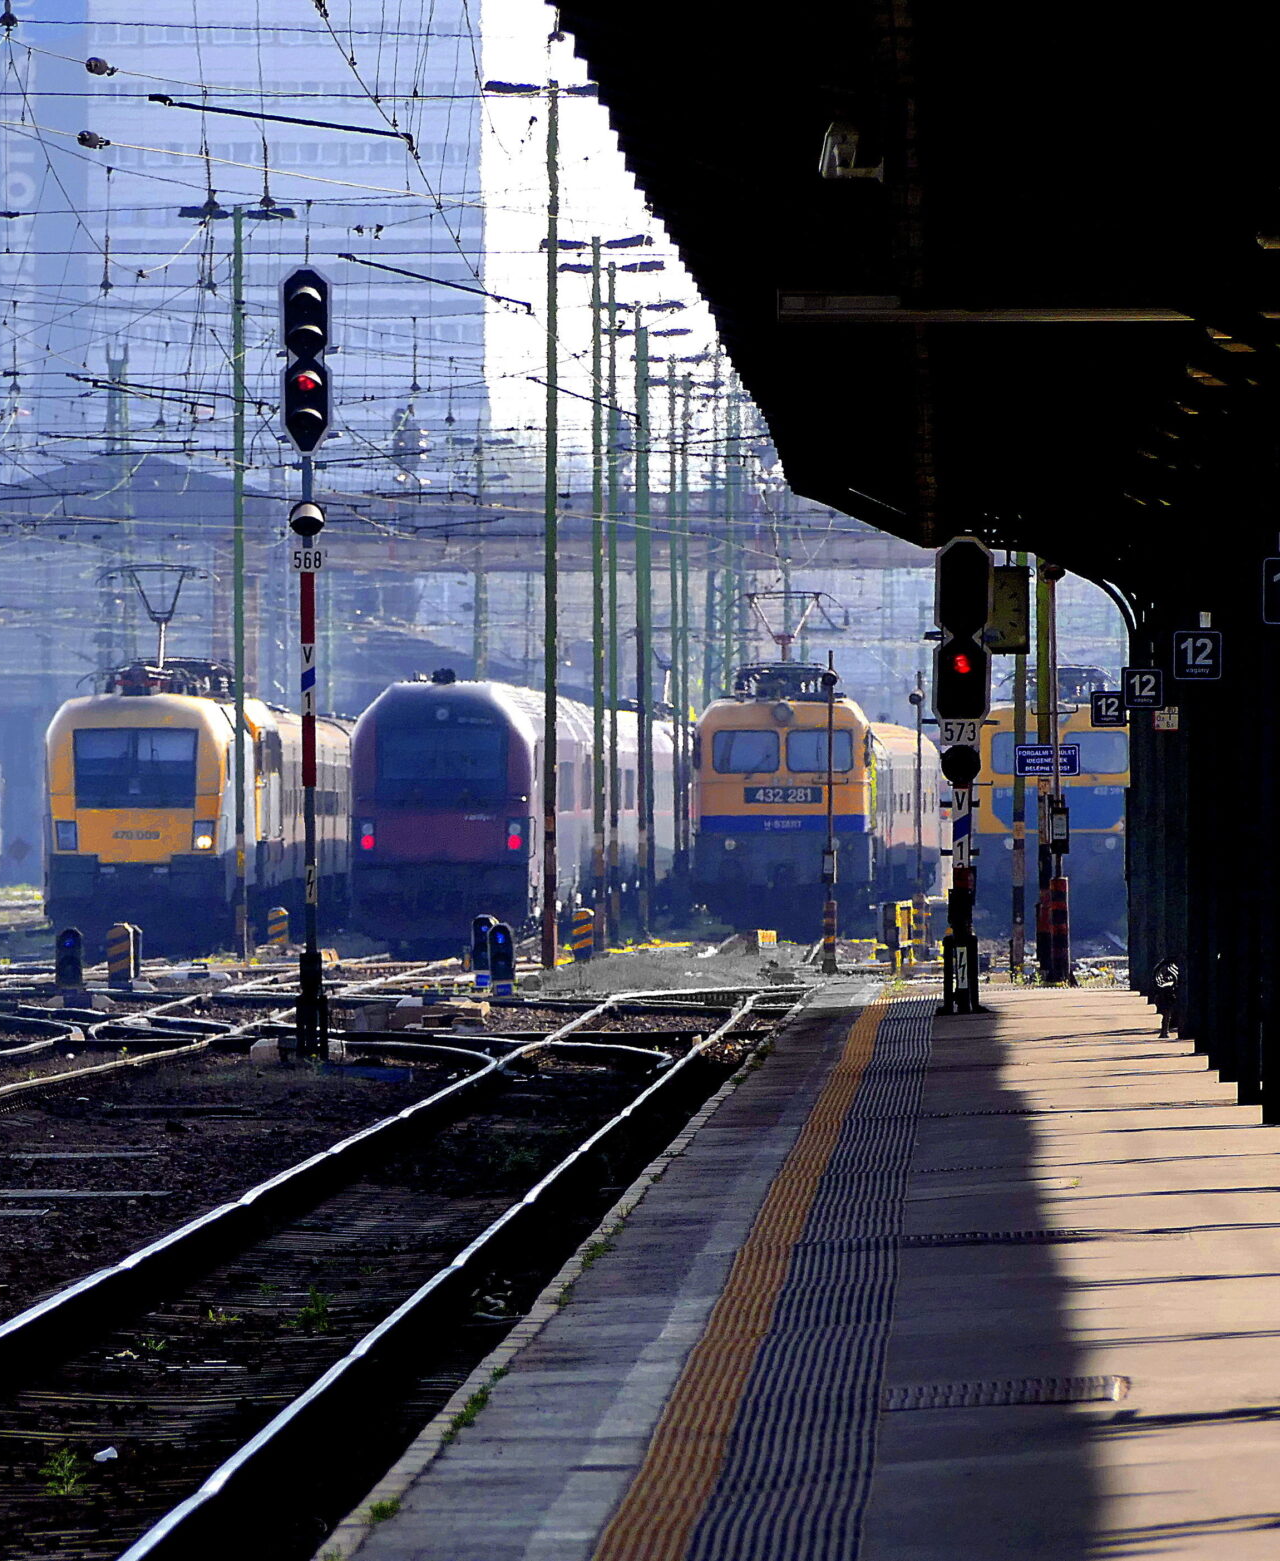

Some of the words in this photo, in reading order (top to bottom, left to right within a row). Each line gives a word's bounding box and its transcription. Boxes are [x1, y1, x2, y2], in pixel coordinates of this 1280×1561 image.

[294, 551, 322, 569] 568
[302, 645, 313, 664] V
[1180, 637, 1213, 665] 12
[1130, 674, 1156, 696] 12
[1097, 697, 1119, 716] 12
[944, 722, 976, 741] 573
[755, 788, 783, 802] 432
[787, 788, 812, 802] 281
[954, 790, 966, 811] V
[956, 841, 964, 861] 1
